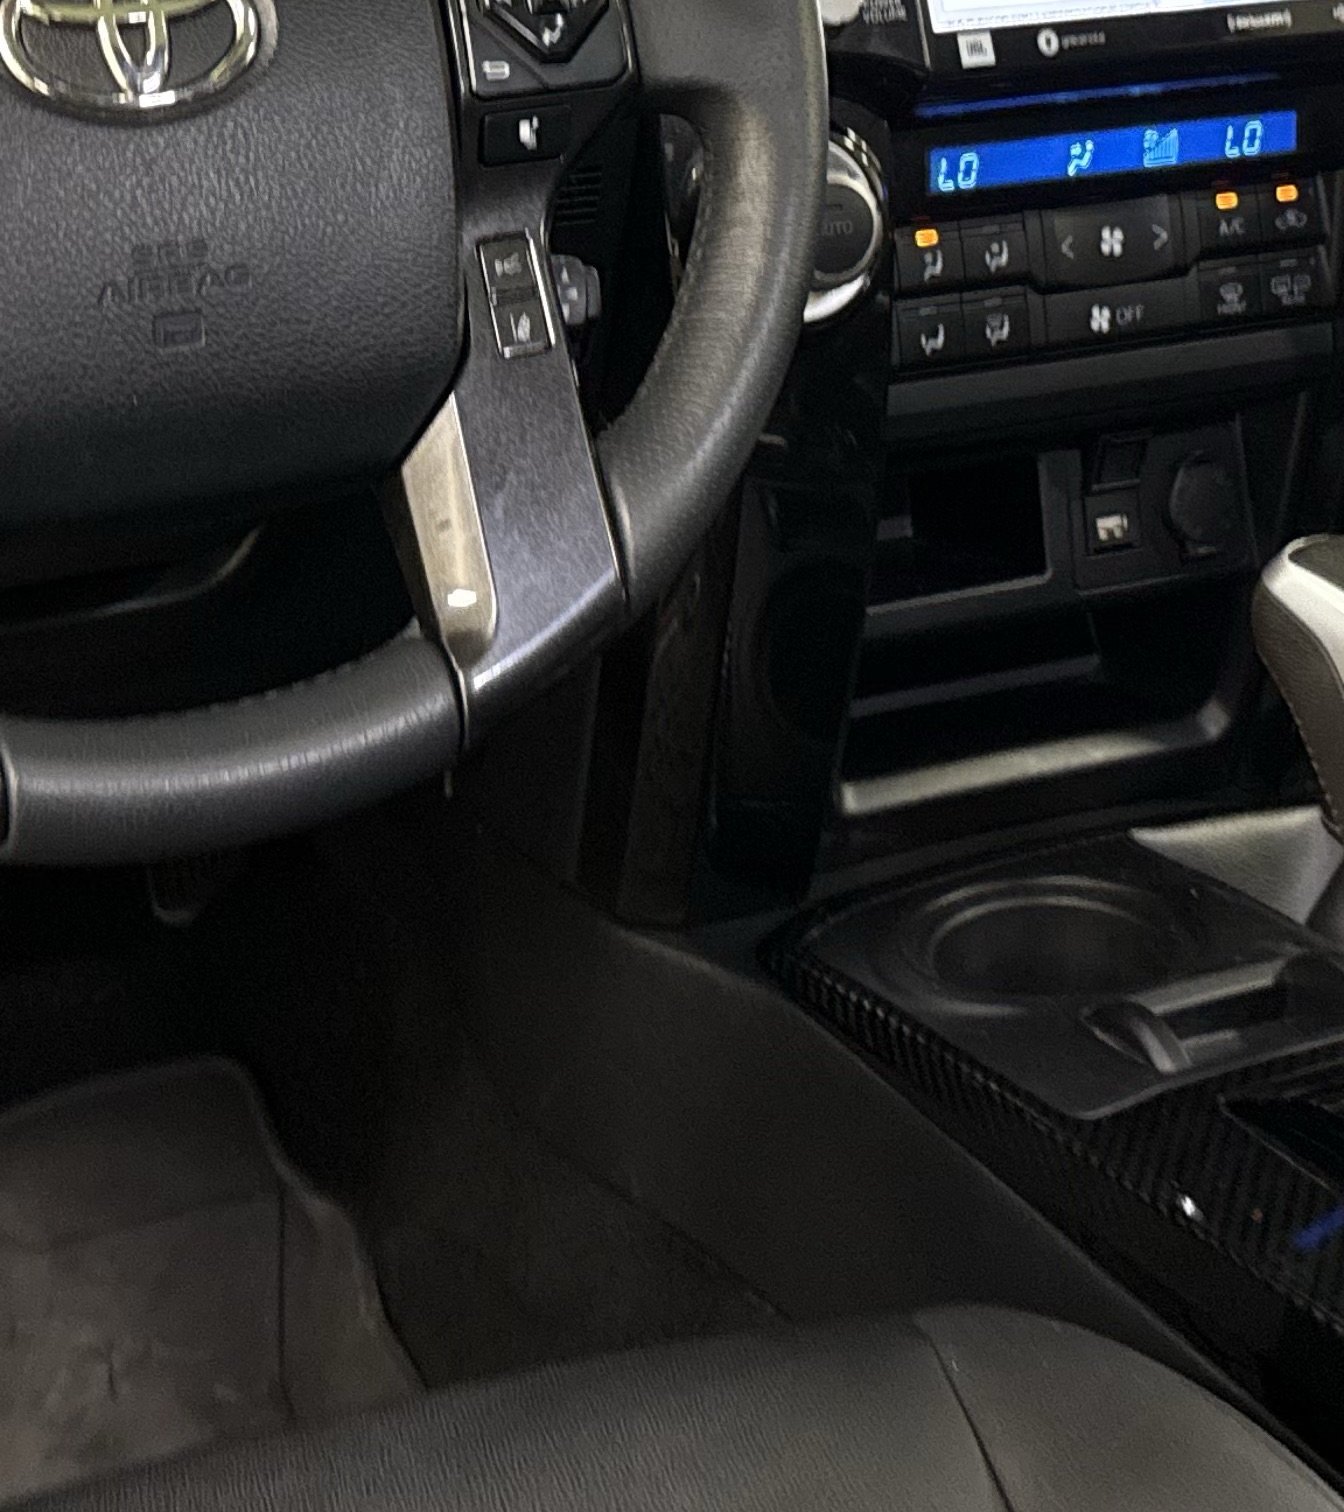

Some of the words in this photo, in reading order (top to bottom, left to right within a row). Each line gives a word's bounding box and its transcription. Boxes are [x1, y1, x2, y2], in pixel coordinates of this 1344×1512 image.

[1224, 120, 1264, 158] LO
[937, 152, 980, 192] LO
[1117, 304, 1145, 325] OFF
